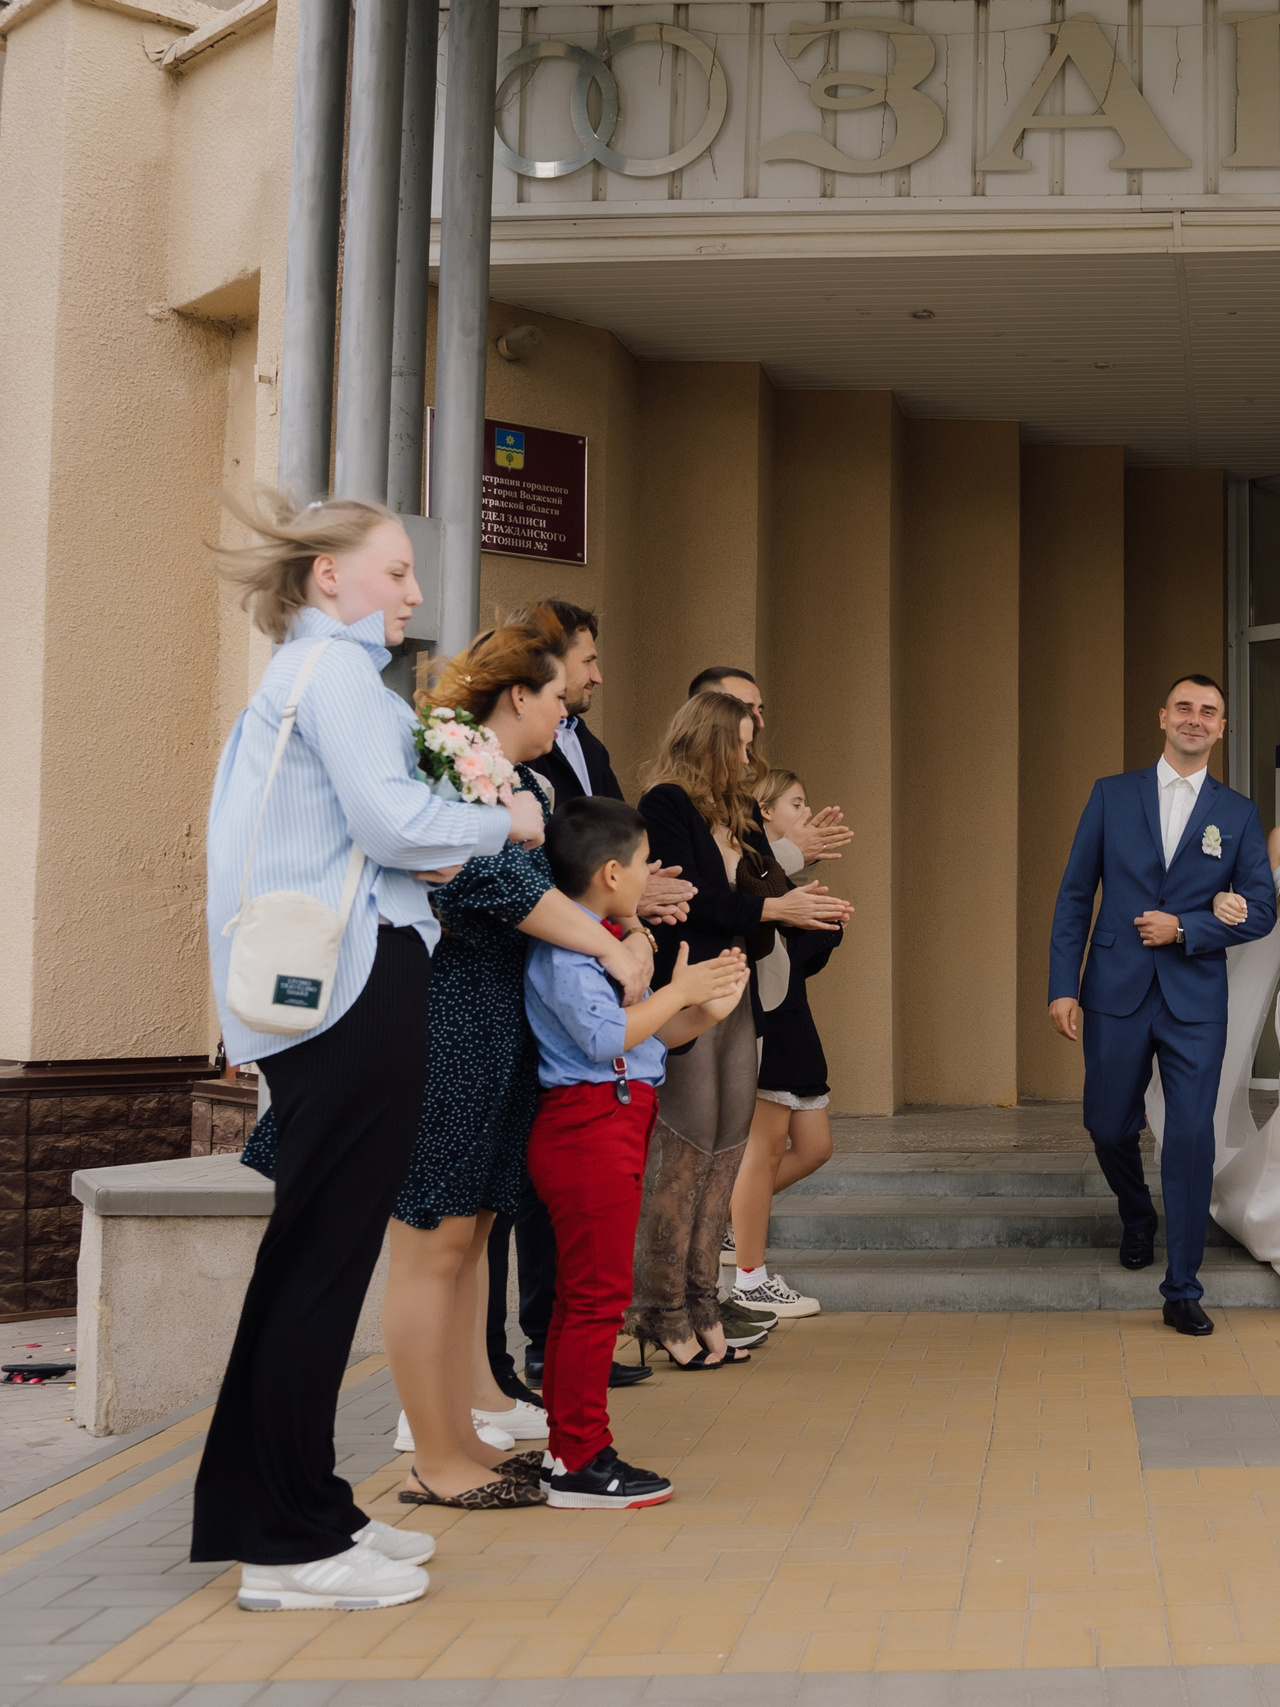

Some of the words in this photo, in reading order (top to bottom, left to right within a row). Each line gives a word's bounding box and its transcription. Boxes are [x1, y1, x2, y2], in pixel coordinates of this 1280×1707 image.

[522, 481, 569, 495] городского
[493, 488, 518, 499] город
[520, 489, 563, 506] Волжский
[526, 503, 560, 516] области
[507, 513, 547, 528] ЗАПИСИ
[487, 522, 567, 543] ГРАЖДАНСКОГО
